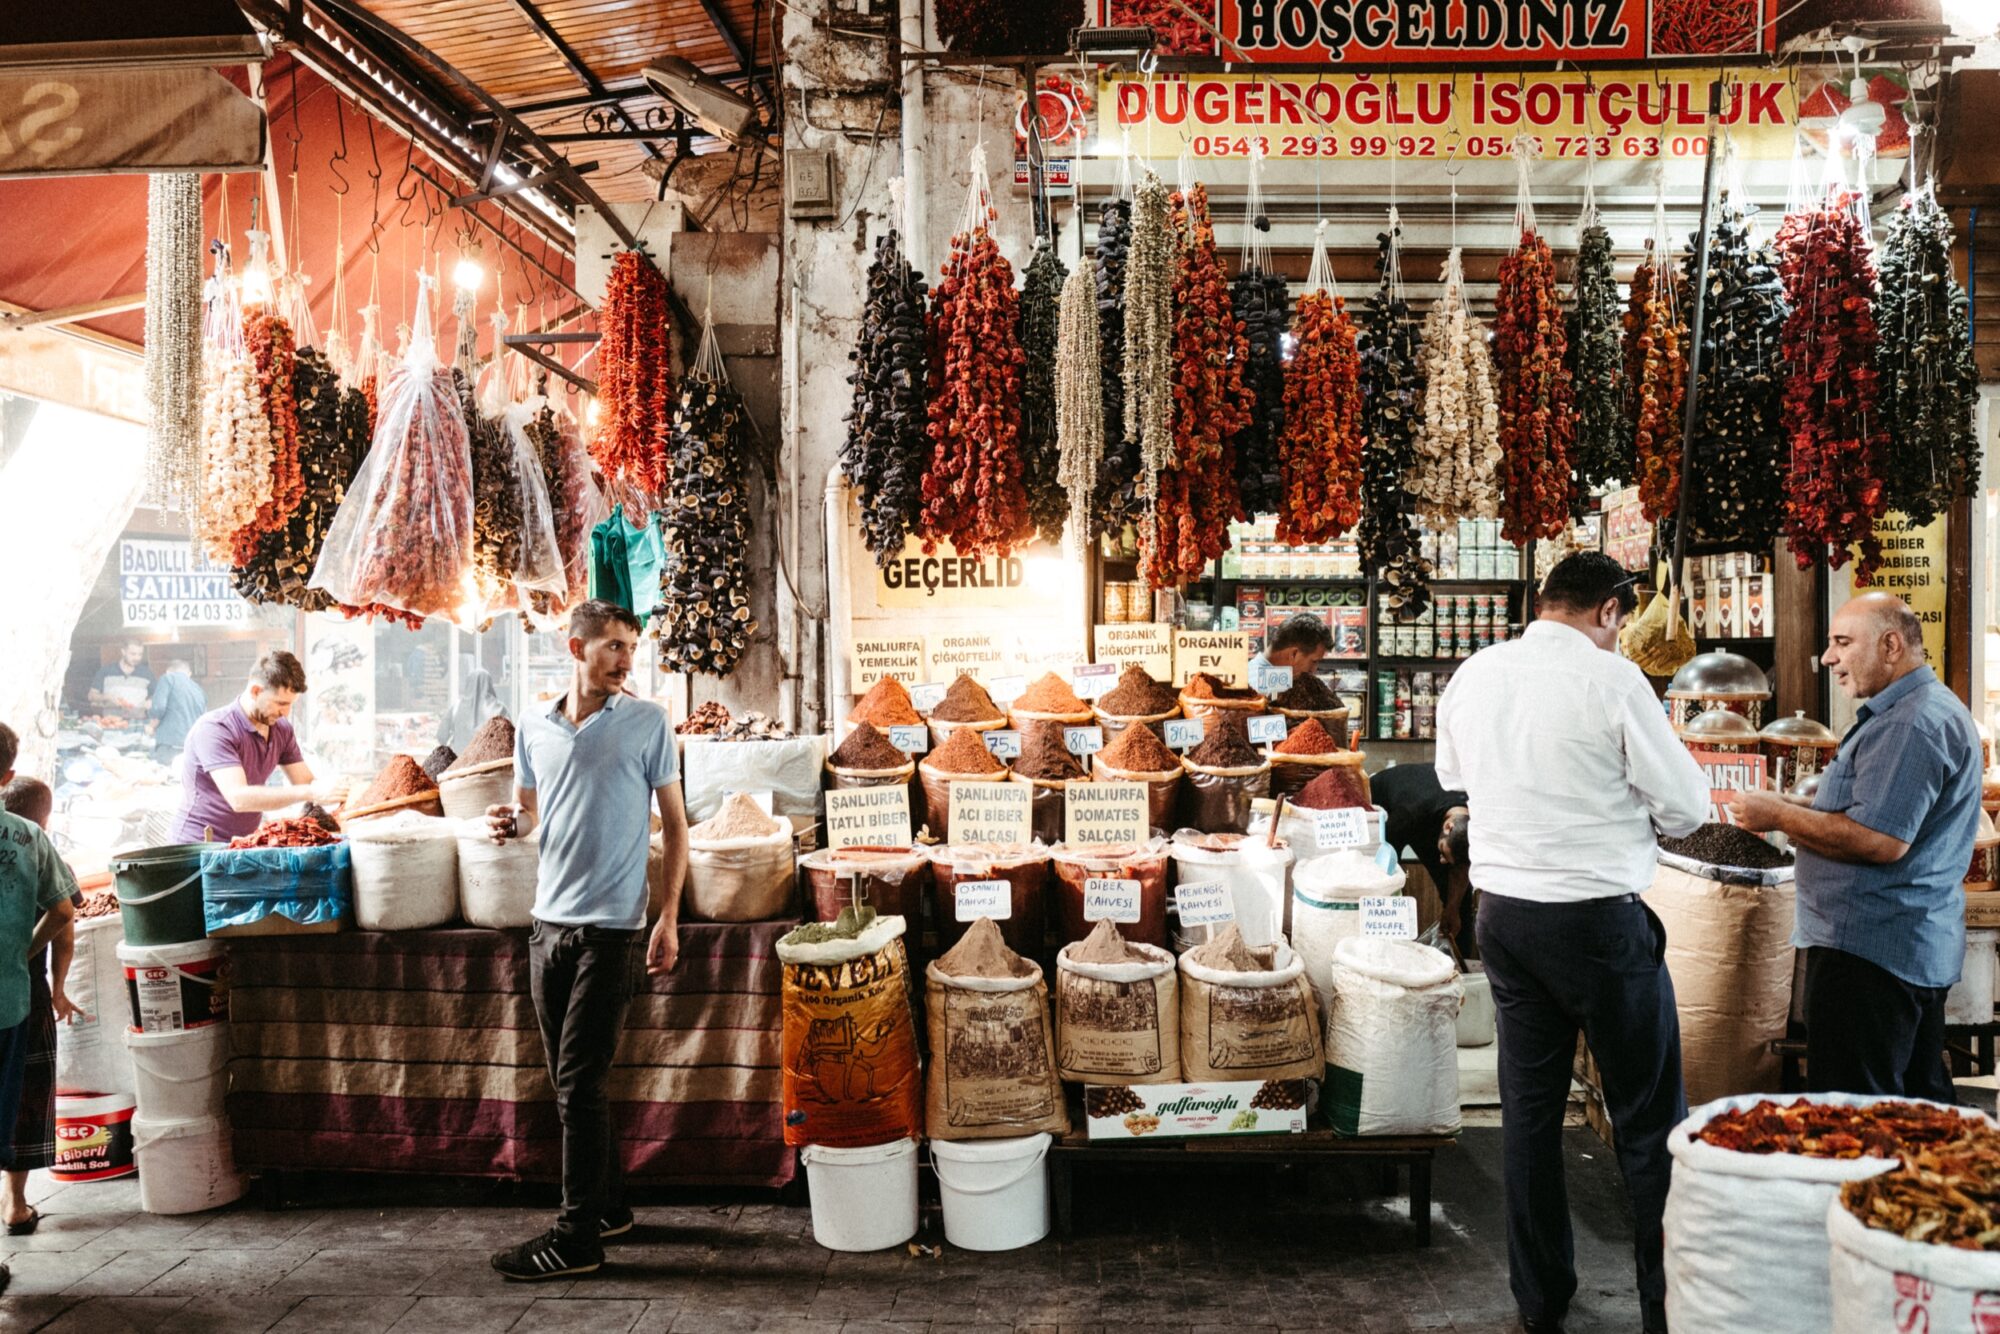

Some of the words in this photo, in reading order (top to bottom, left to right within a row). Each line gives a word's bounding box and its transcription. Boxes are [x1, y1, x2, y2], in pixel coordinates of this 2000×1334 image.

[1116, 73, 1451, 125] DÜGEROĞLU
[1473, 72, 1786, 137] İSOTÇULUK
[1281, 136, 1338, 156] 293
[1350, 136, 1387, 156] 99
[1398, 136, 1436, 156] 92
[1555, 136, 1611, 156] 723
[1623, 136, 1660, 156] 63
[1671, 136, 1708, 156] 00
[1889, 572, 1930, 589] EKŞİSİ
[128, 603, 167, 621] 0554
[173, 603, 199, 621] 124
[204, 603, 221, 621] 03
[942, 636, 991, 648] ORGANİK
[1108, 628, 1157, 641] ORGANİK
[1178, 634, 1243, 649] ORGANİK
[856, 641, 921, 655] ŞANLIURFA
[858, 656, 918, 668] YEMEKLİK
[1199, 655, 1222, 668] EV
[862, 672, 877, 683] EV
[832, 790, 904, 812] ŞANLIURFA
[955, 786, 1028, 803] ŞANLIURFA
[1068, 787, 1146, 806] ŞANLIURFA
[829, 816, 865, 831] TATLI
[869, 810, 908, 827] BİBER
[958, 808, 980, 822] ACI
[984, 807, 1023, 823] BİBER
[1074, 808, 1140, 822] DOMATES
[1078, 829, 1137, 845] SALÇASI
[1155, 1094, 1239, 1117] gaffaroğlu
[63, 1144, 108, 1161] Biberli
[88, 1160, 111, 1170] Sos
